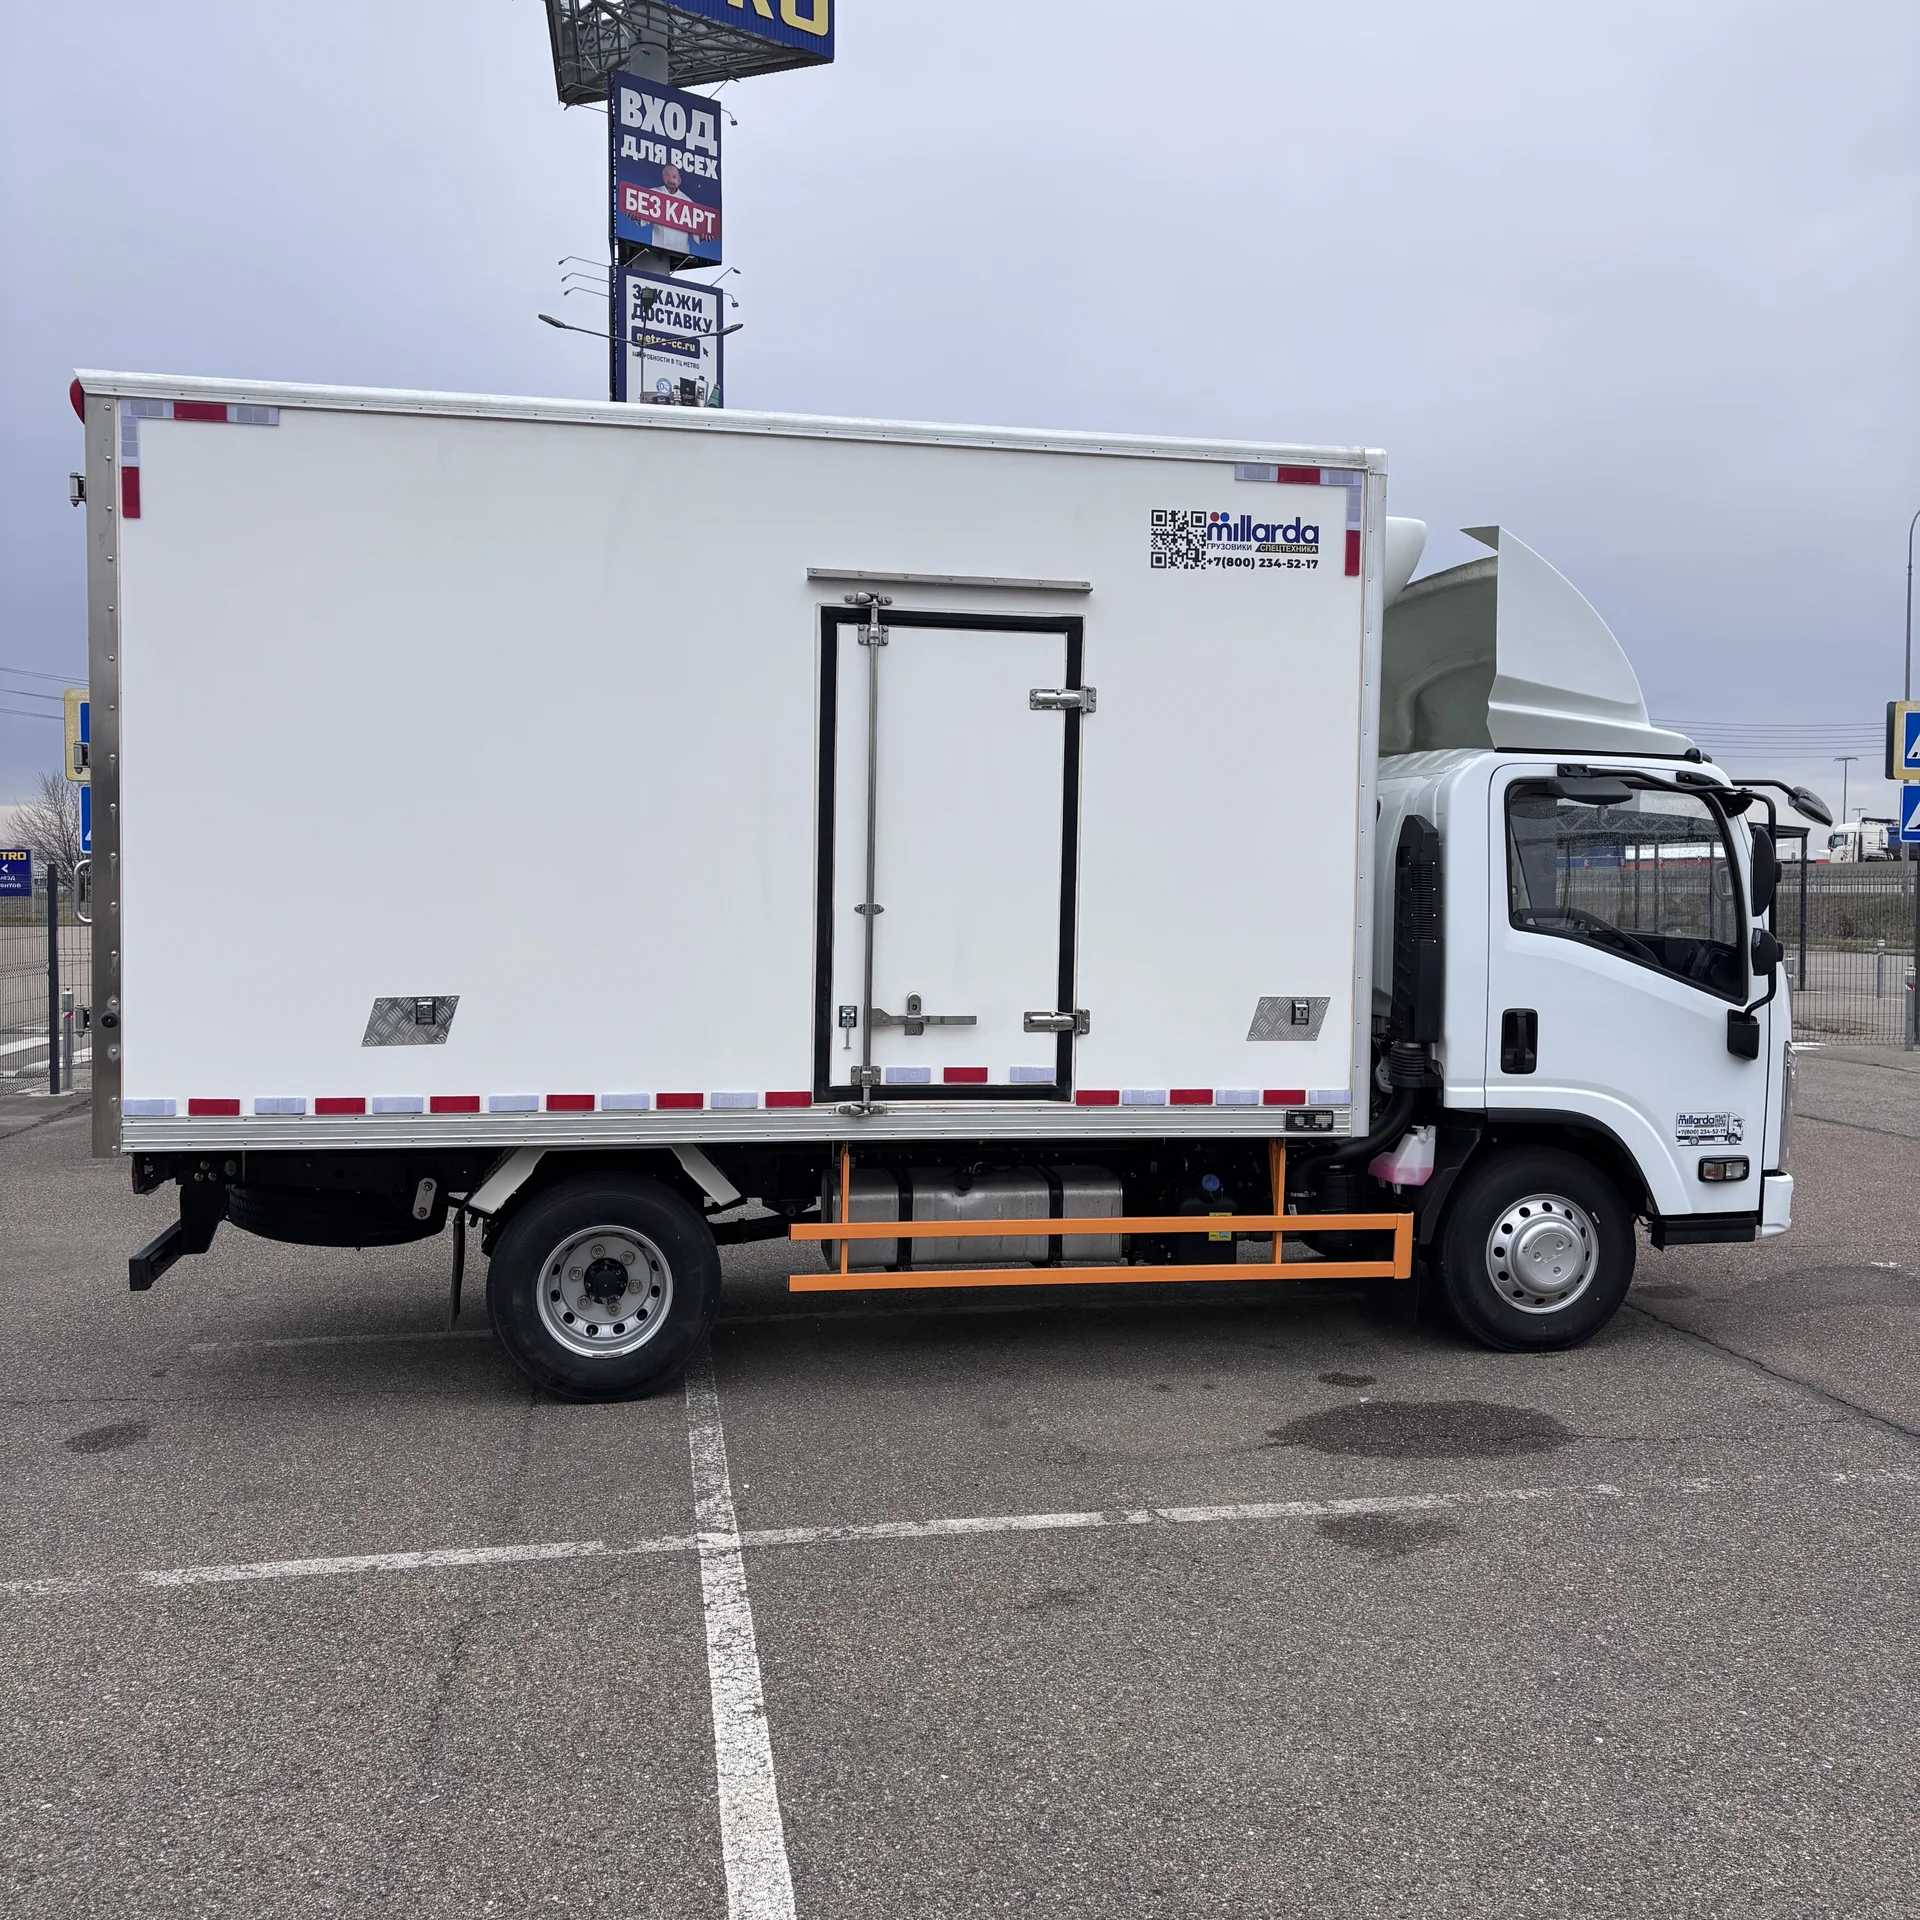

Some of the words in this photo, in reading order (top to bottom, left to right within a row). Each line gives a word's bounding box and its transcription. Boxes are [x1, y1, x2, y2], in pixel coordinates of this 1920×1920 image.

[620, 87, 718, 157] ВХОД
[620, 134, 667, 165] ДЛЯ
[671, 148, 719, 180] ВСЕХ
[625, 187, 661, 218] БЕЗ
[665, 199, 716, 234] КАРТ
[632, 283, 703, 313] ЗКАЖИ
[631, 302, 713, 334] ДОСТАВКУ
[683, 361, 700, 369] METRO
[1207, 511, 1319, 544] millarda
[1207, 543, 1252, 551] ГРУЗОВИКИ
[1259, 543, 1317, 554] СПЕЦТЕХНИКА
[1207, 556, 1255, 570] +7(800)
[1259, 558, 1319, 569] 234-52-17
[0, 852, 26, 860] TRO
[1678, 1114, 1715, 1125] millarda
